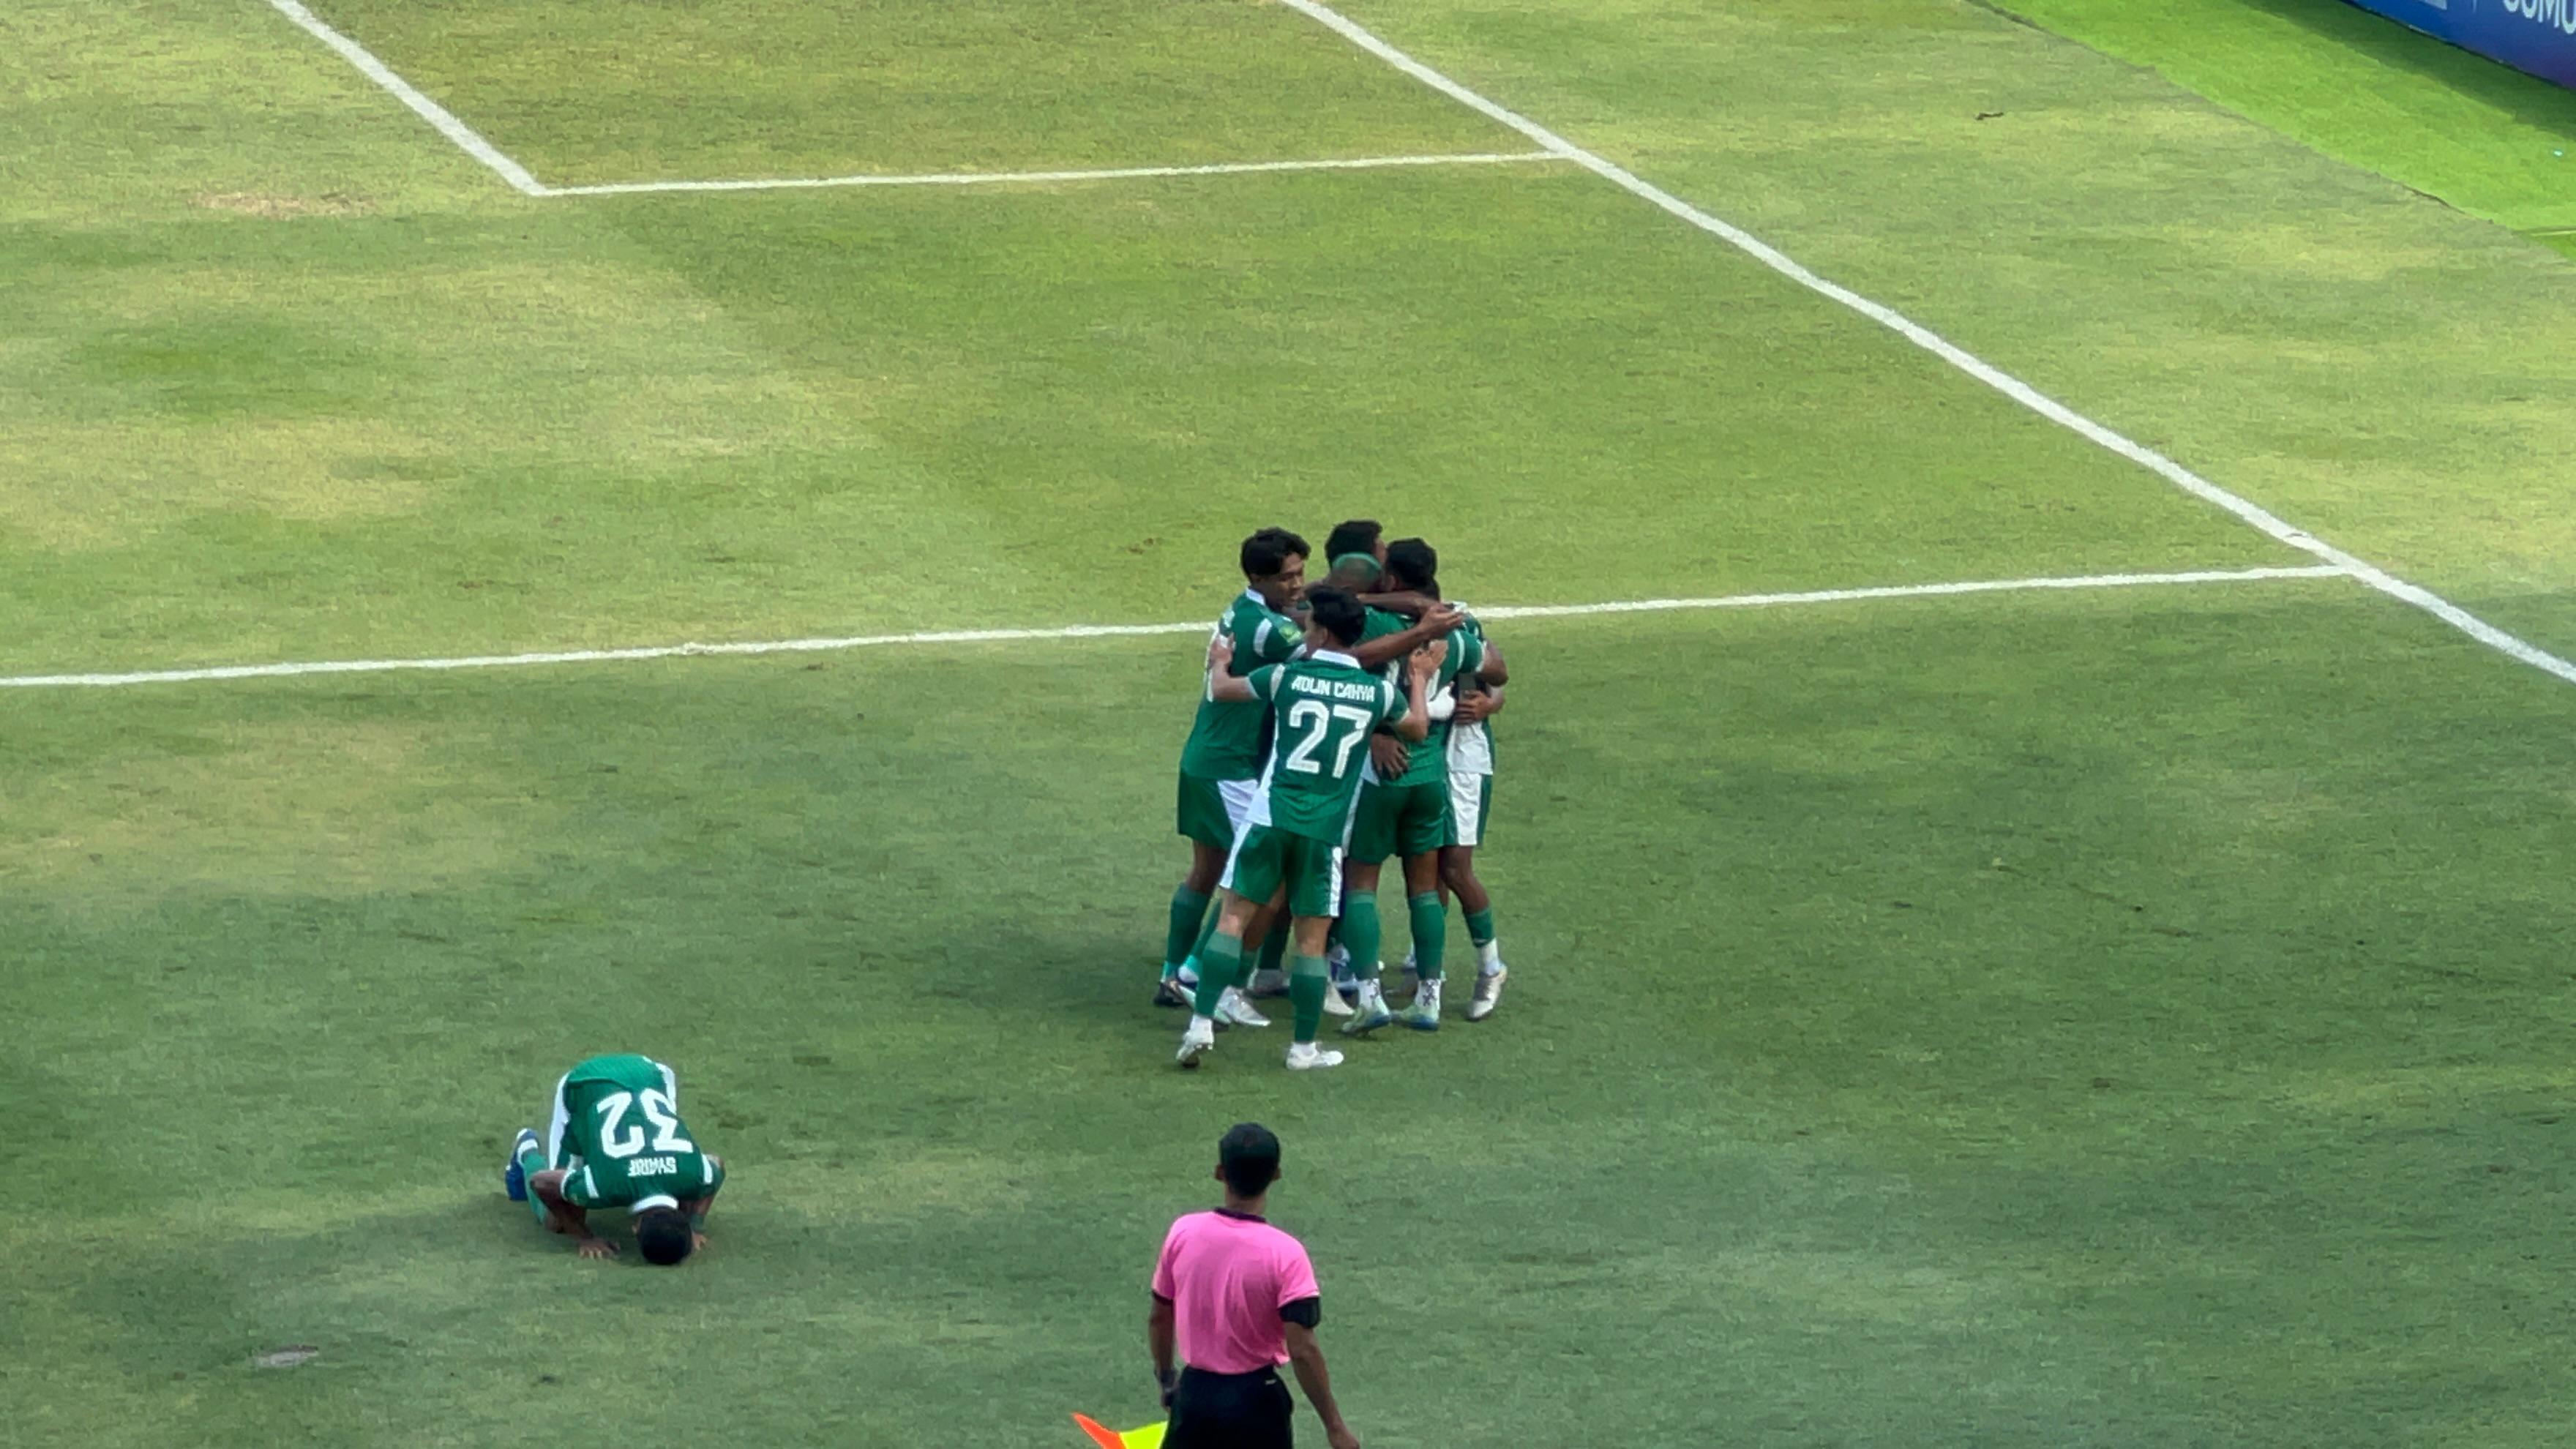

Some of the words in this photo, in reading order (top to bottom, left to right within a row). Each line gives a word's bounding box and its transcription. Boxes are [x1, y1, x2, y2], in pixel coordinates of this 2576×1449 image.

[1291, 675, 1330, 695] ADLIN
[1334, 682, 1375, 702] CAHYA
[1286, 700, 1372, 779] 27
[596, 1088, 693, 1158] 32
